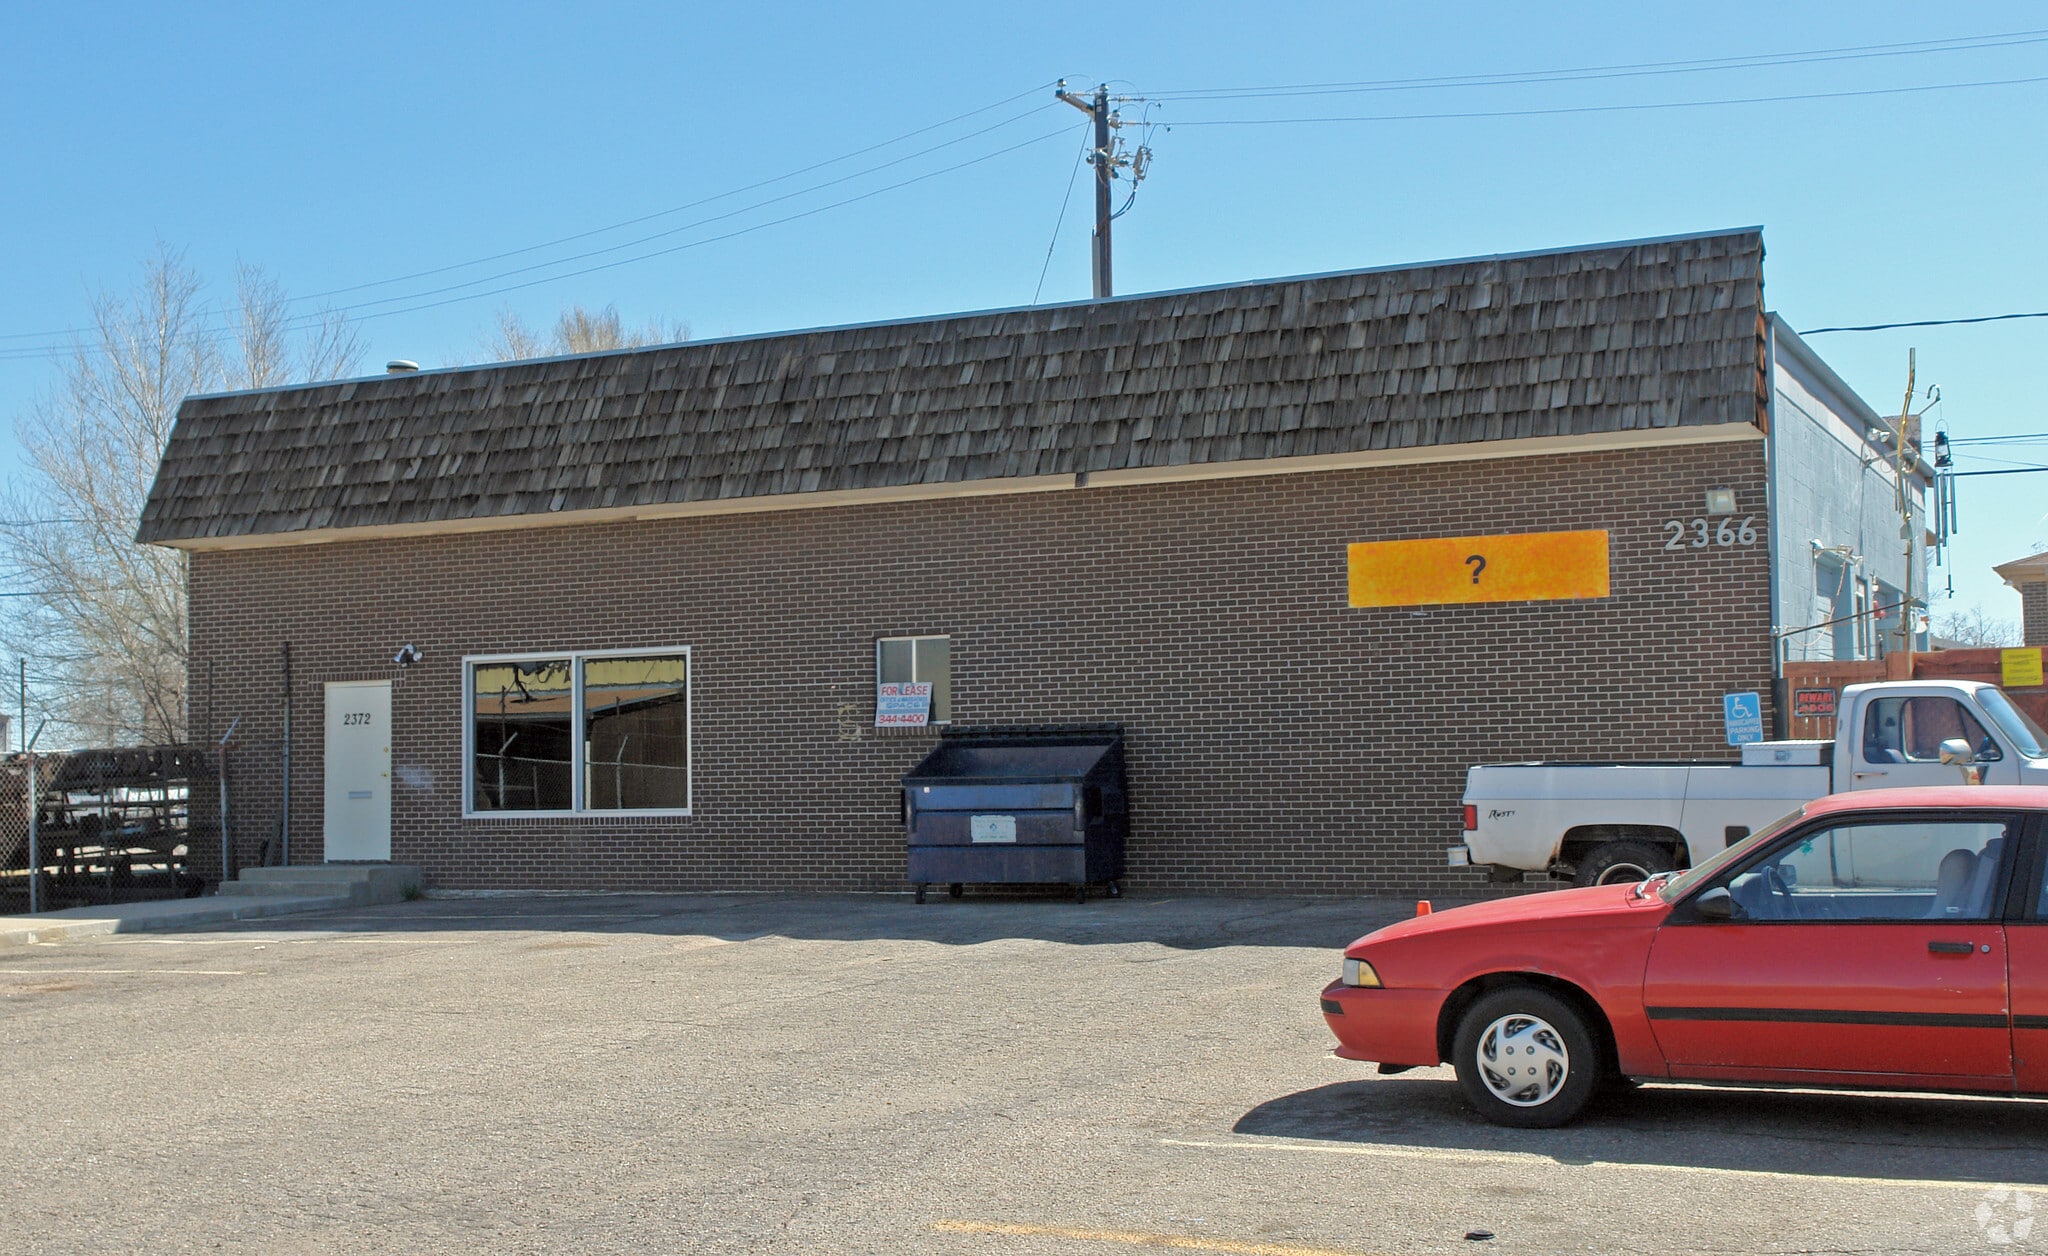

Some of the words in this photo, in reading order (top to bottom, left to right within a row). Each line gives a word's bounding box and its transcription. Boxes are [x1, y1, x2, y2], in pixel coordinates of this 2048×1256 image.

[1663, 516, 1758, 550] 2366
[1465, 554, 1487, 585] ?
[881, 686, 898, 696] FOR
[900, 685, 928, 695] LEASE
[1799, 692, 1833, 702] BEWARE
[343, 712, 371, 726] 2372
